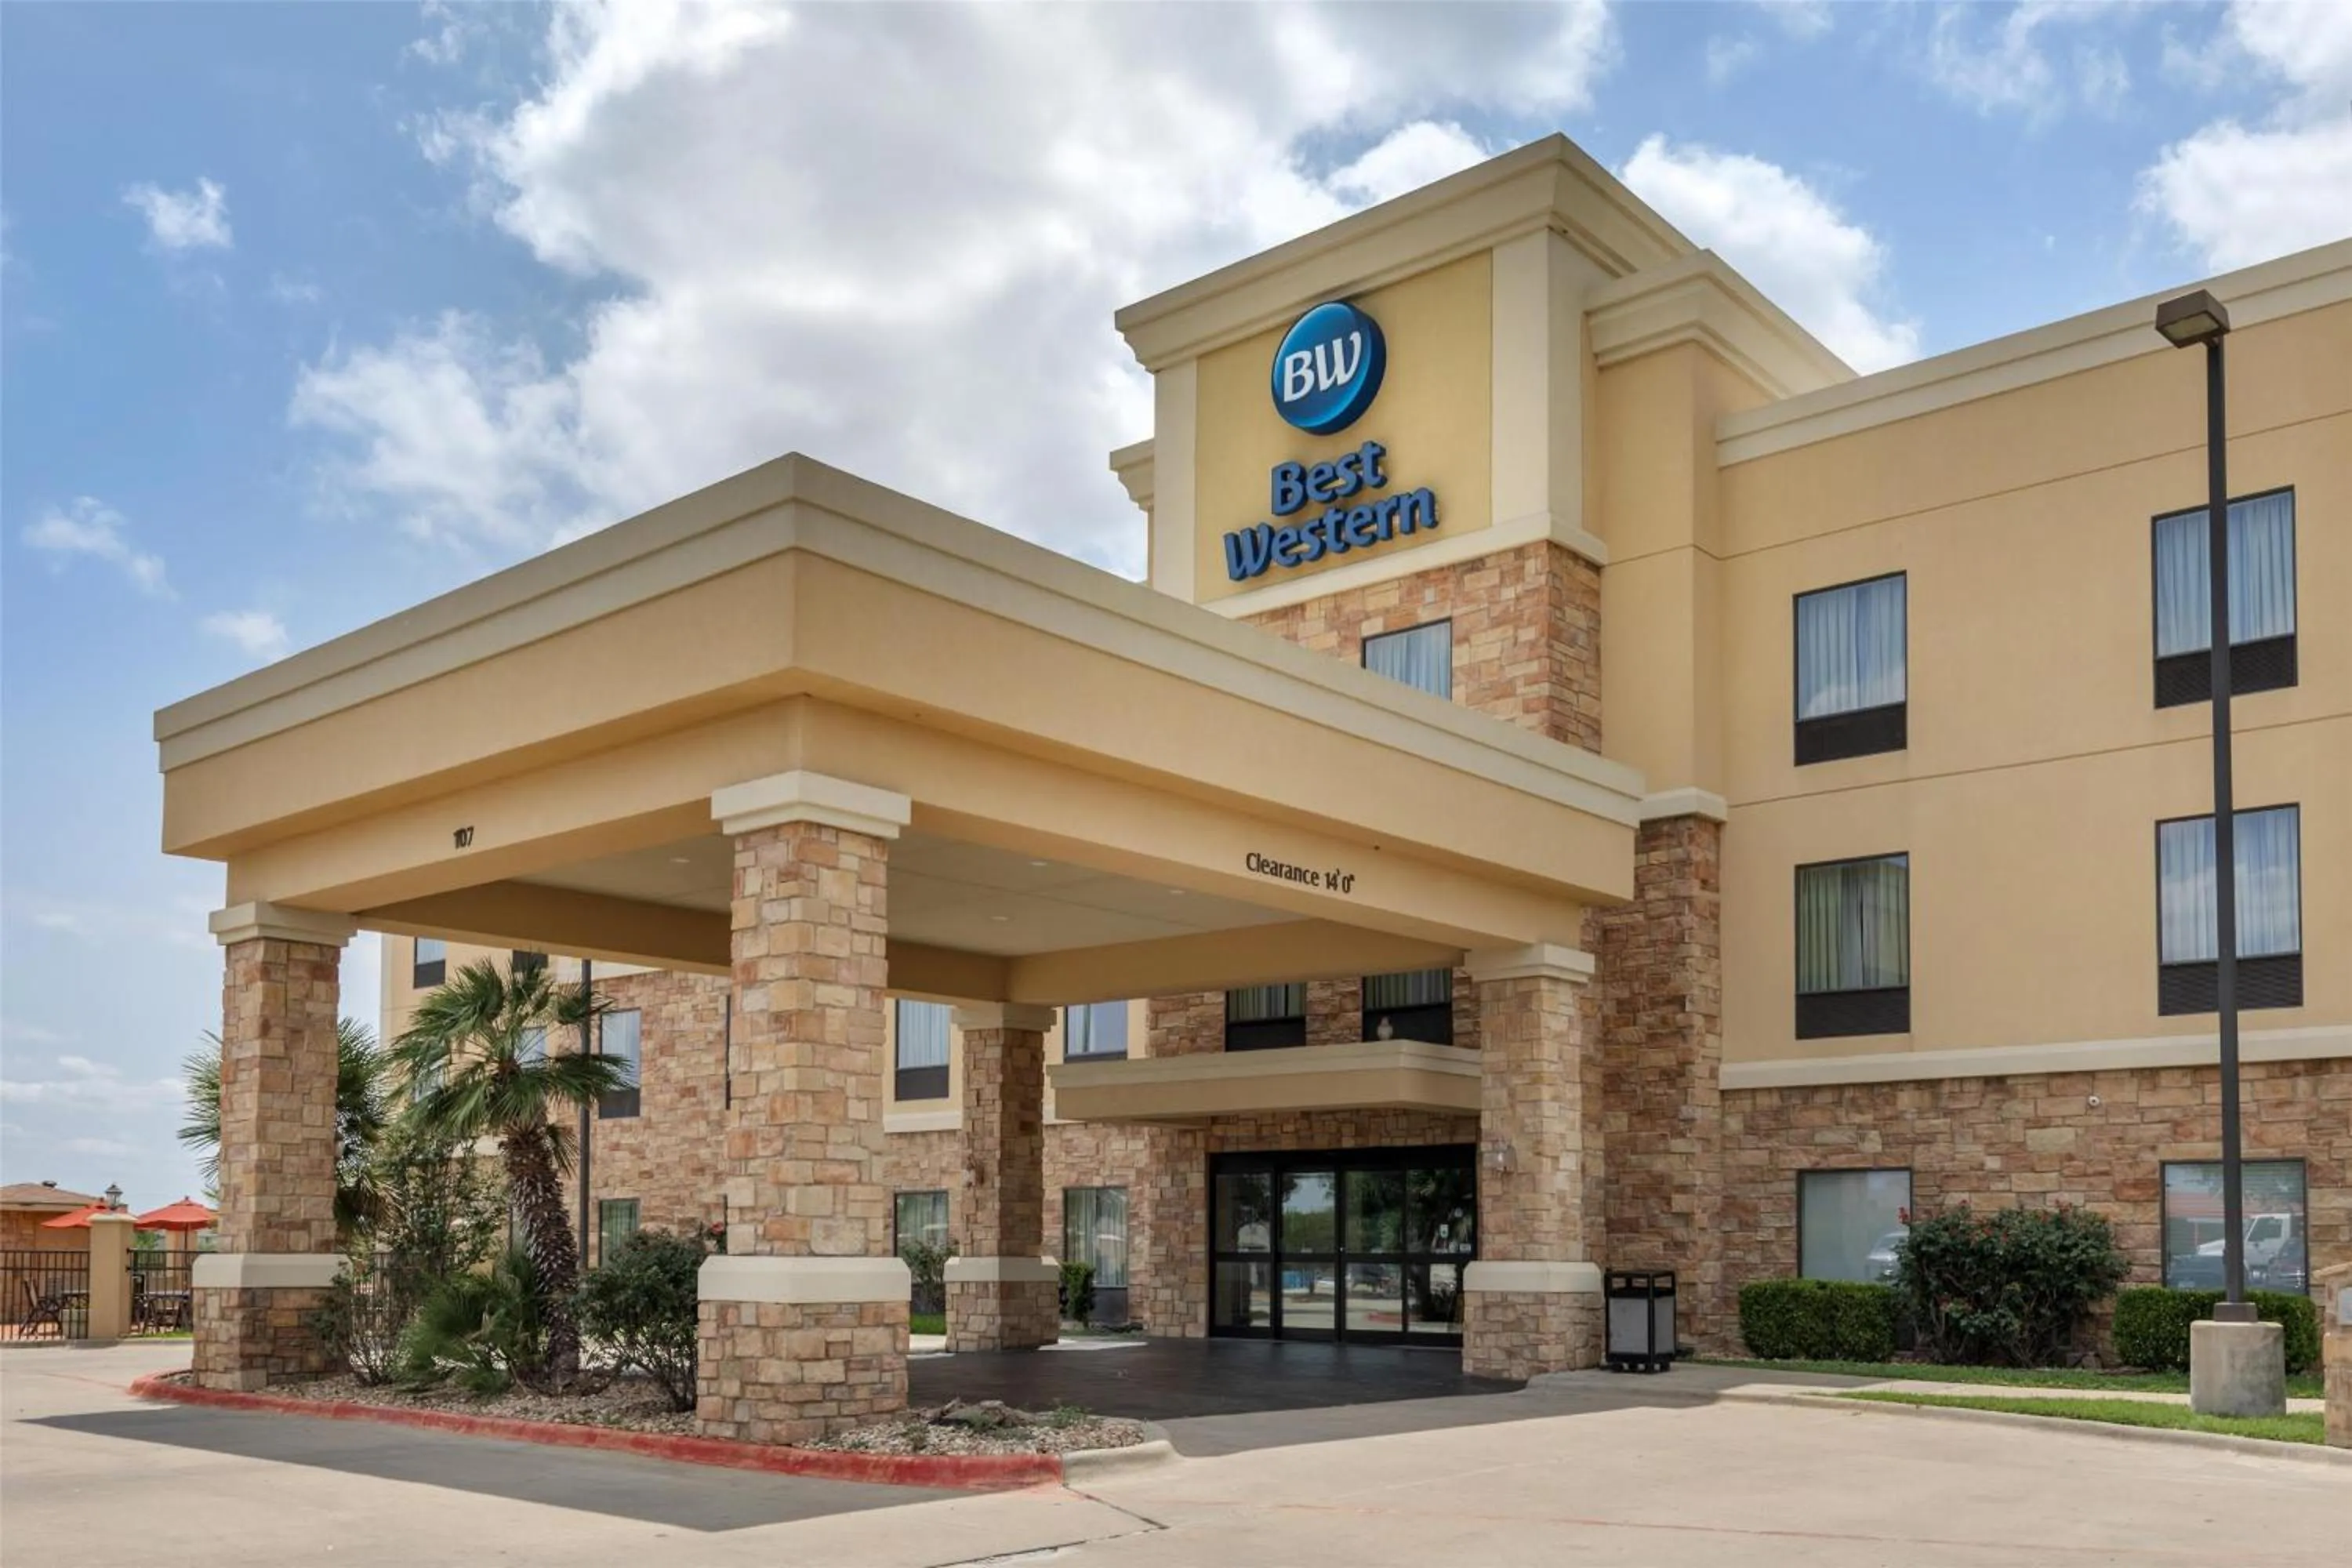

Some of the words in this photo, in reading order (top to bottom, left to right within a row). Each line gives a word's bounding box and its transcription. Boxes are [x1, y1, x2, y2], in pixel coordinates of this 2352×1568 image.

[1283, 332, 1362, 402] BW
[1272, 441, 1387, 516] Best
[1224, 487, 1439, 581] Western
[453, 826, 474, 849] 107
[1246, 852, 1319, 887] Clearance
